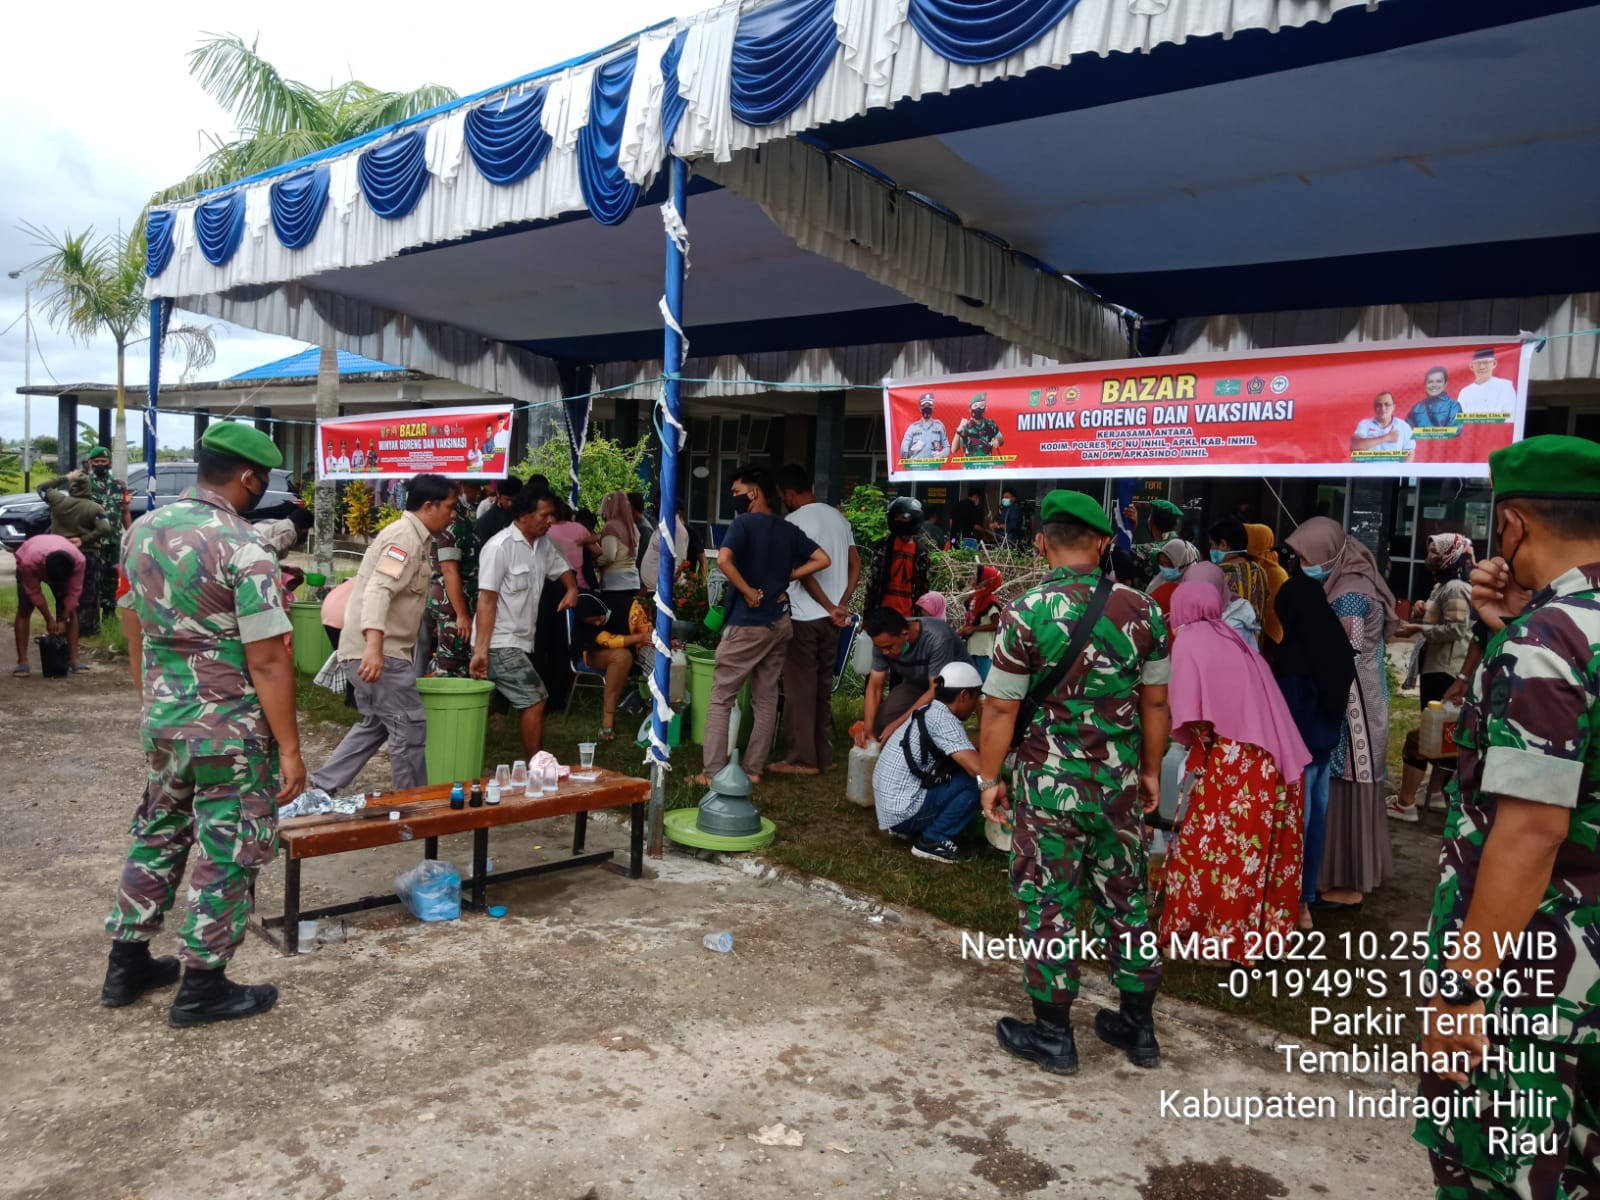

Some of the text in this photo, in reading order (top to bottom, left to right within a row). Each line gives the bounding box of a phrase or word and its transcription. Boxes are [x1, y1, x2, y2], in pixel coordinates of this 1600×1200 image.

[1101, 373, 1197, 404] BAZAR
[1017, 399, 1294, 431] MINYAK GORENG DAN VAKSINASI
[399, 422, 428, 438] BAZAR
[1097, 427, 1193, 439] KERJASAMA ANTARA
[378, 437, 467, 450] MINYAK GORENG DAN VAKSINASI
[1111, 440, 1123, 448] PC
[1125, 440, 1140, 448] NU
[1141, 438, 1170, 448] INHIL,
[1172, 437, 1198, 447] APKL
[1200, 437, 1225, 446] KAB.
[1227, 435, 1257, 445] INHIL
[1082, 448, 1208, 460] DAN DPW APKASINDO INHIL
